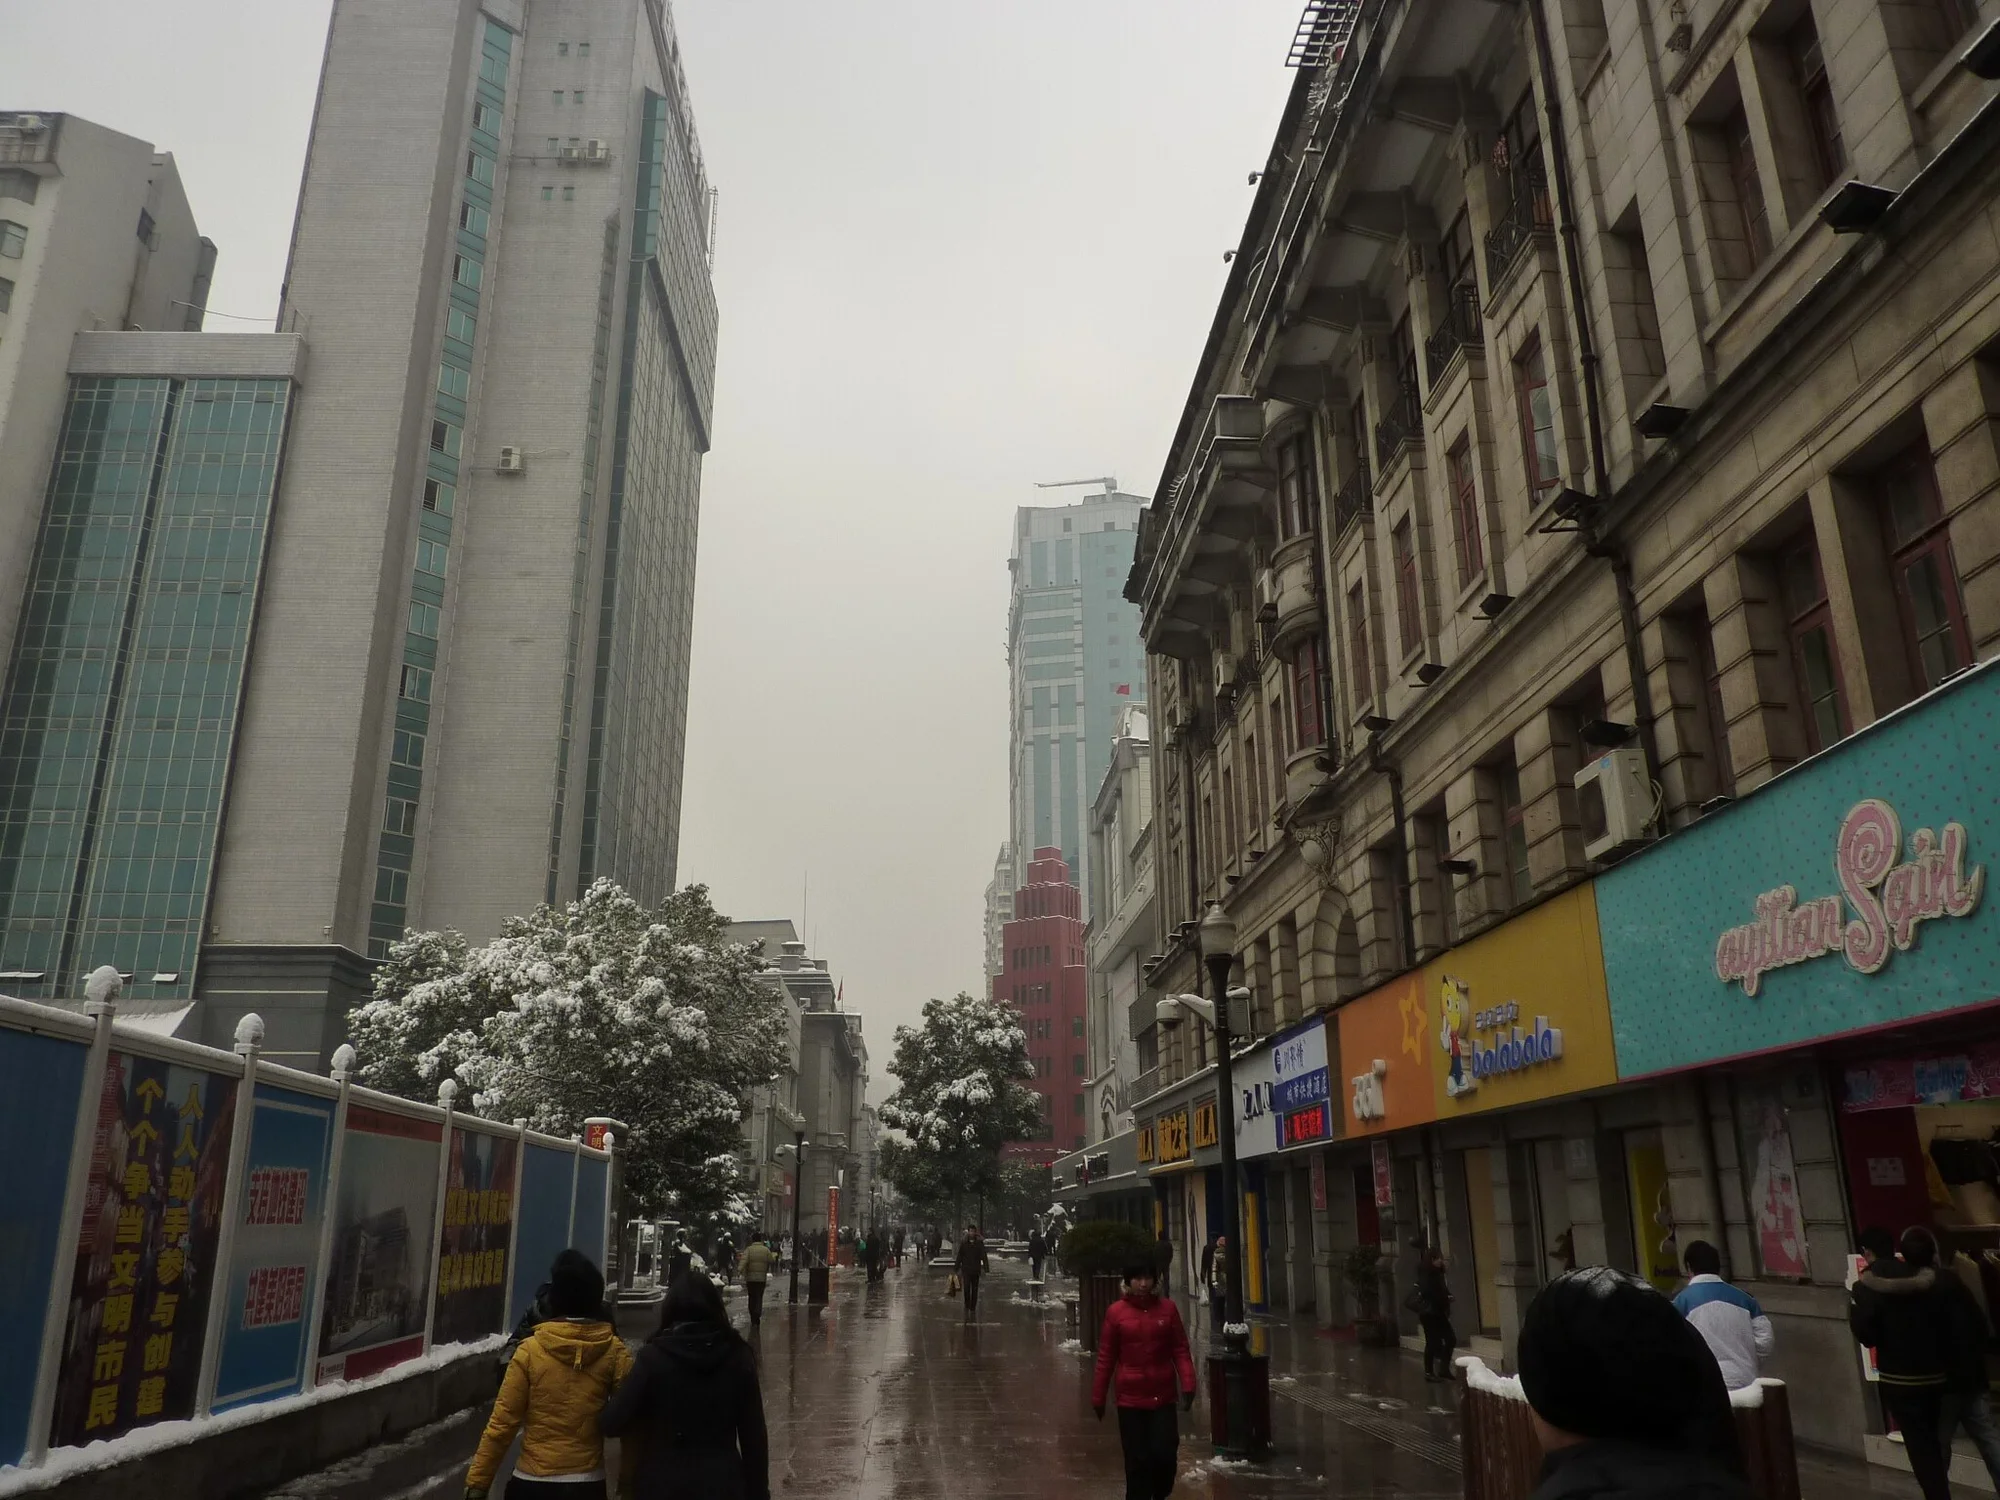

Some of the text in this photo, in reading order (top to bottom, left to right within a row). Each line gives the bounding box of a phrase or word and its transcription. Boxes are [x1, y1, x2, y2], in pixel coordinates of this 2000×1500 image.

[1472, 1016, 1562, 1079] balabala
[1286, 1072, 1327, 1104] 城市快捷酒店
[591, 1124, 603, 1148] 文明
[1194, 1104, 1218, 1150] HLA
[85, 1077, 164, 1432] 个个争当文明市民
[136, 1082, 205, 1418] 人人动手参与创建
